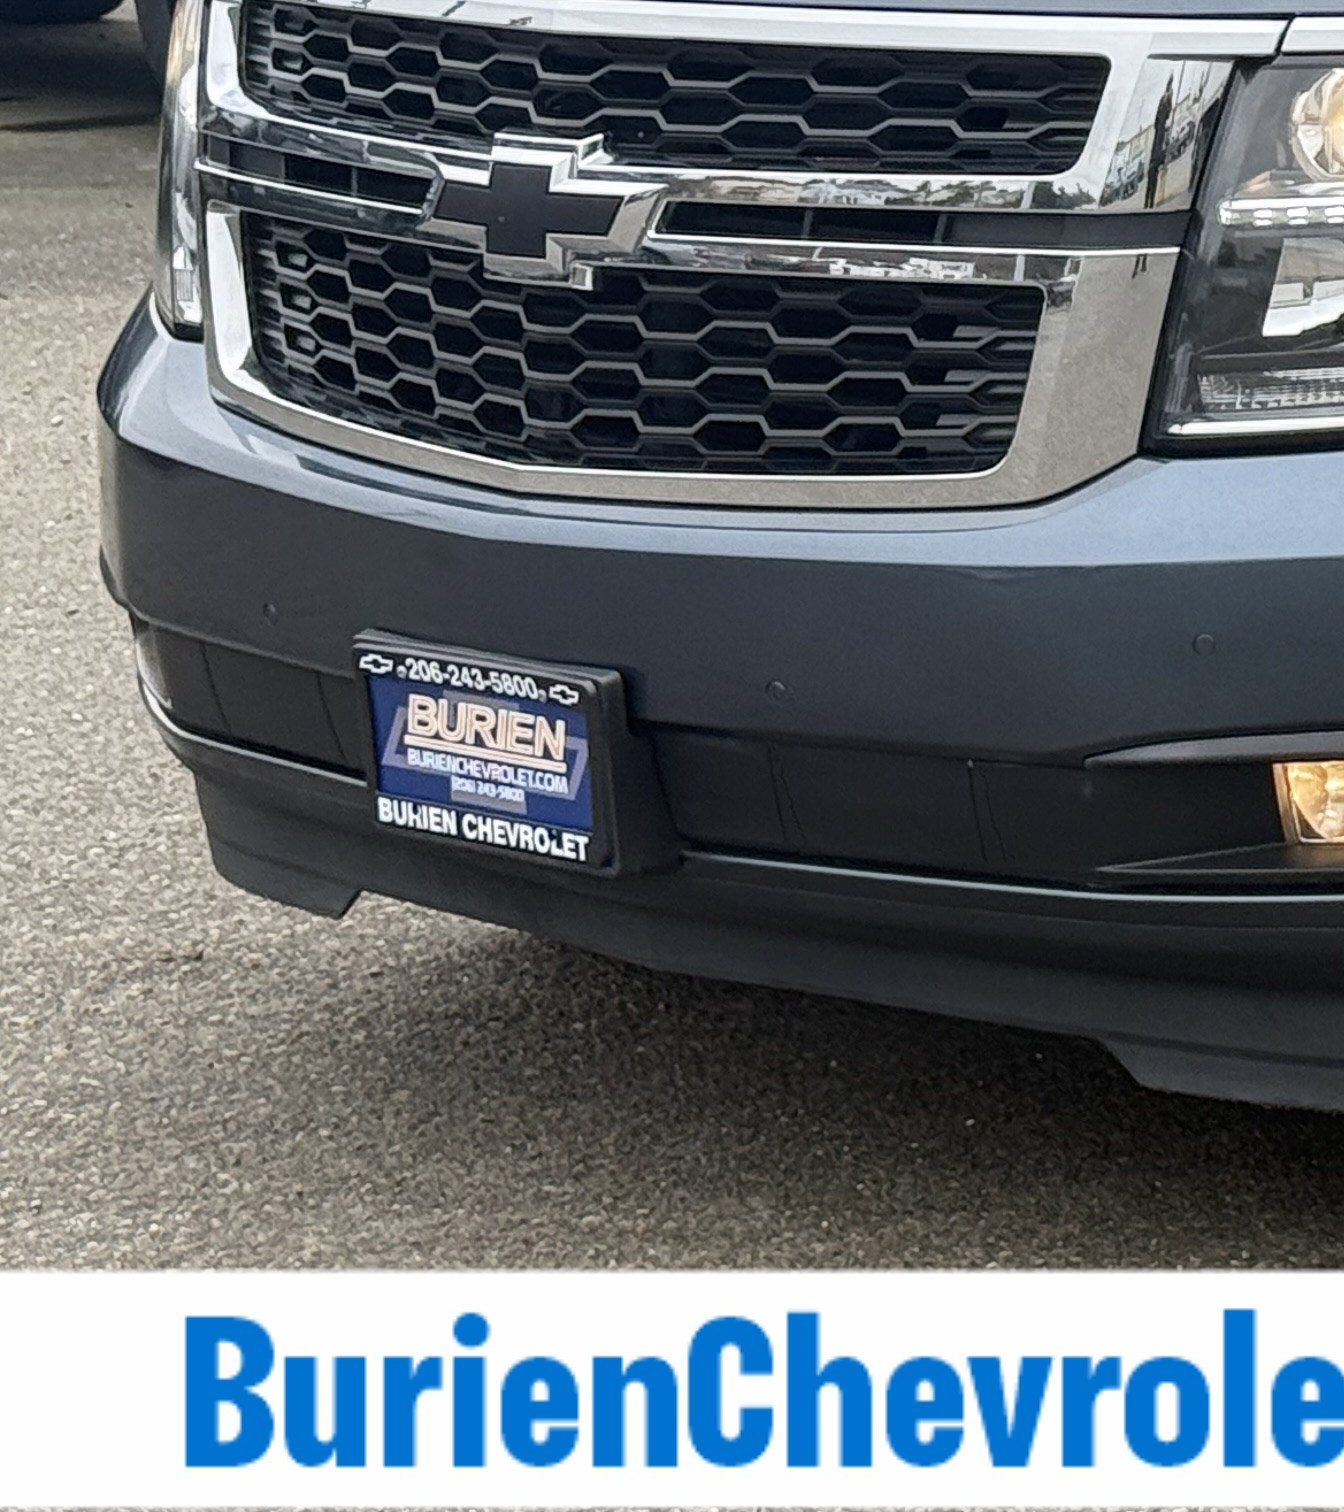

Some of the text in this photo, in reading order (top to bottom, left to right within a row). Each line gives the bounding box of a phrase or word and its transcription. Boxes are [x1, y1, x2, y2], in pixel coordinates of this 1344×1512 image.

[404, 657, 539, 701] 206-243-5800
[406, 692, 566, 759] BURIEN
[407, 747, 569, 795] BURIENCHEVROLET.COM
